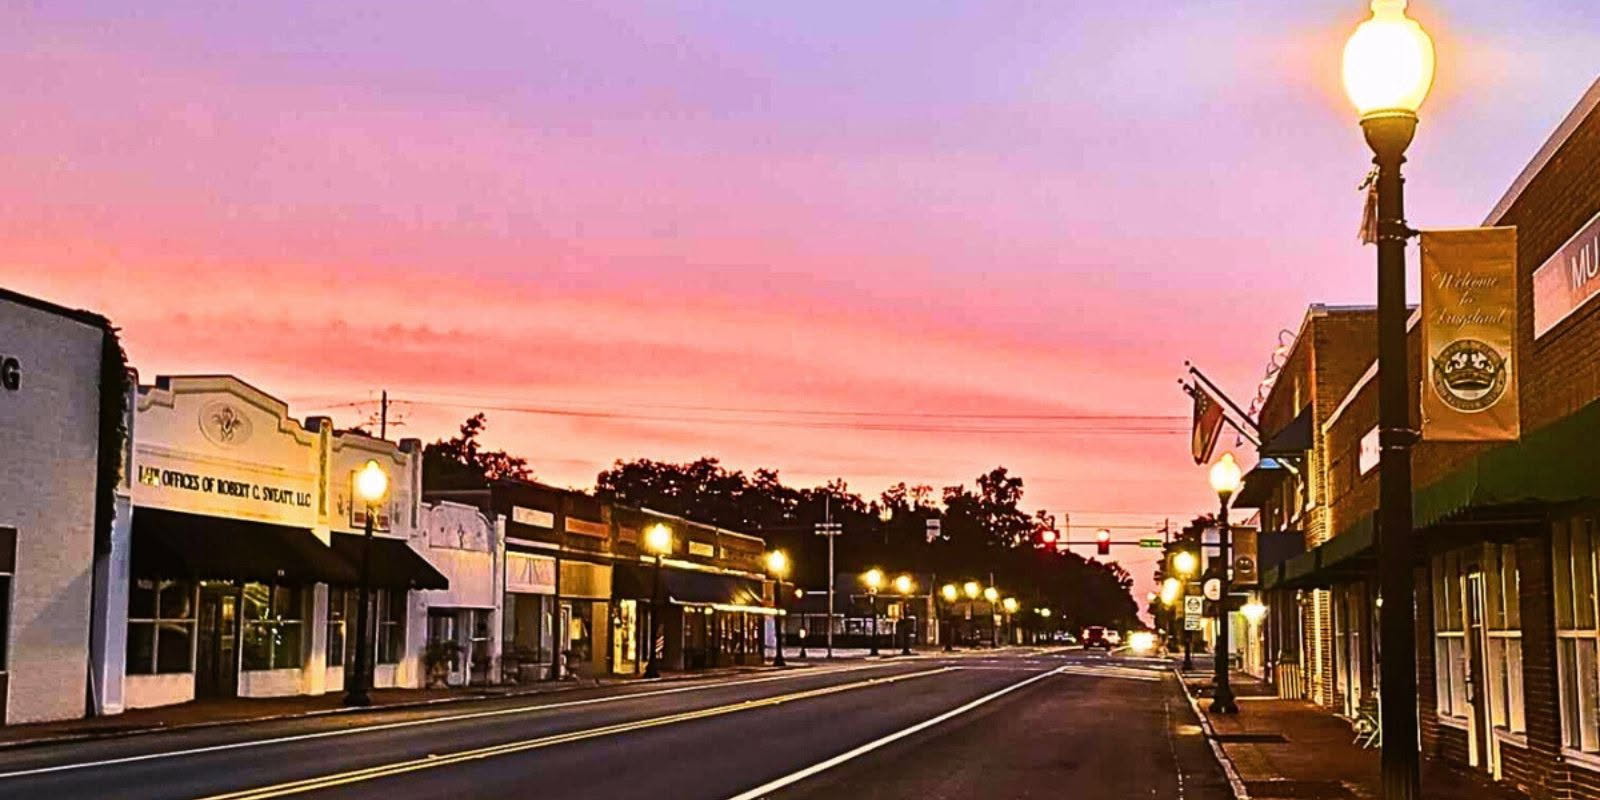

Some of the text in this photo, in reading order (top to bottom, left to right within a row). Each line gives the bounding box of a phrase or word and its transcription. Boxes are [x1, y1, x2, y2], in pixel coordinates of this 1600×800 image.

[1432, 271, 1497, 290] Welcome
[0, 354, 20, 391] G
[162, 469, 200, 491] OFFICES
[202, 476, 215, 493] OF
[217, 479, 250, 499] ROBERT
[296, 492, 312, 508] LLC
